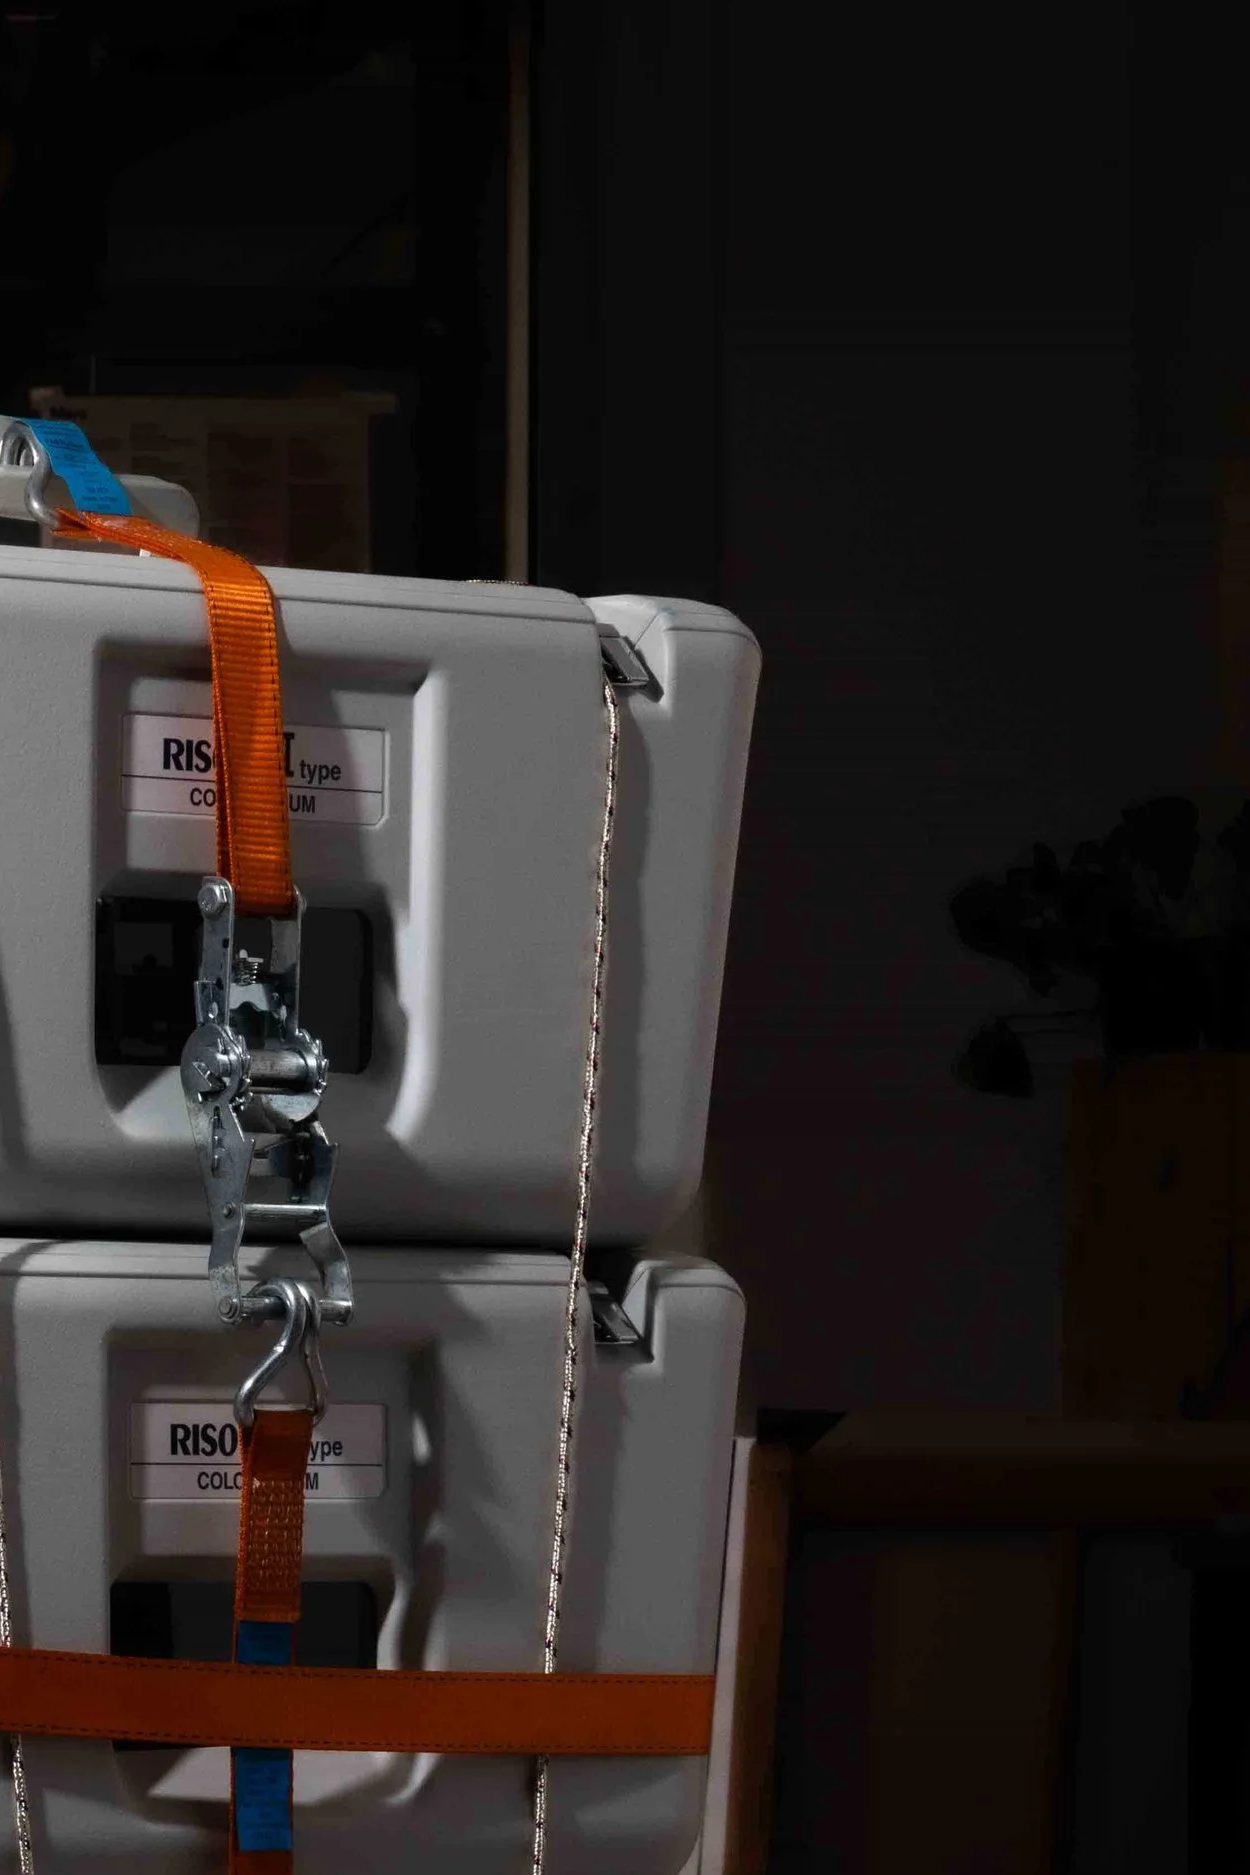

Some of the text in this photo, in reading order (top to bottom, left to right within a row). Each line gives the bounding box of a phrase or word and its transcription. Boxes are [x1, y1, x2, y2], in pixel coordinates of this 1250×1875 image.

[163, 738, 215, 773] RIS
[301, 759, 342, 785] type
[289, 795, 316, 814] UM
[170, 1424, 343, 1463] RISO ype
[197, 1471, 242, 1490] COLO
